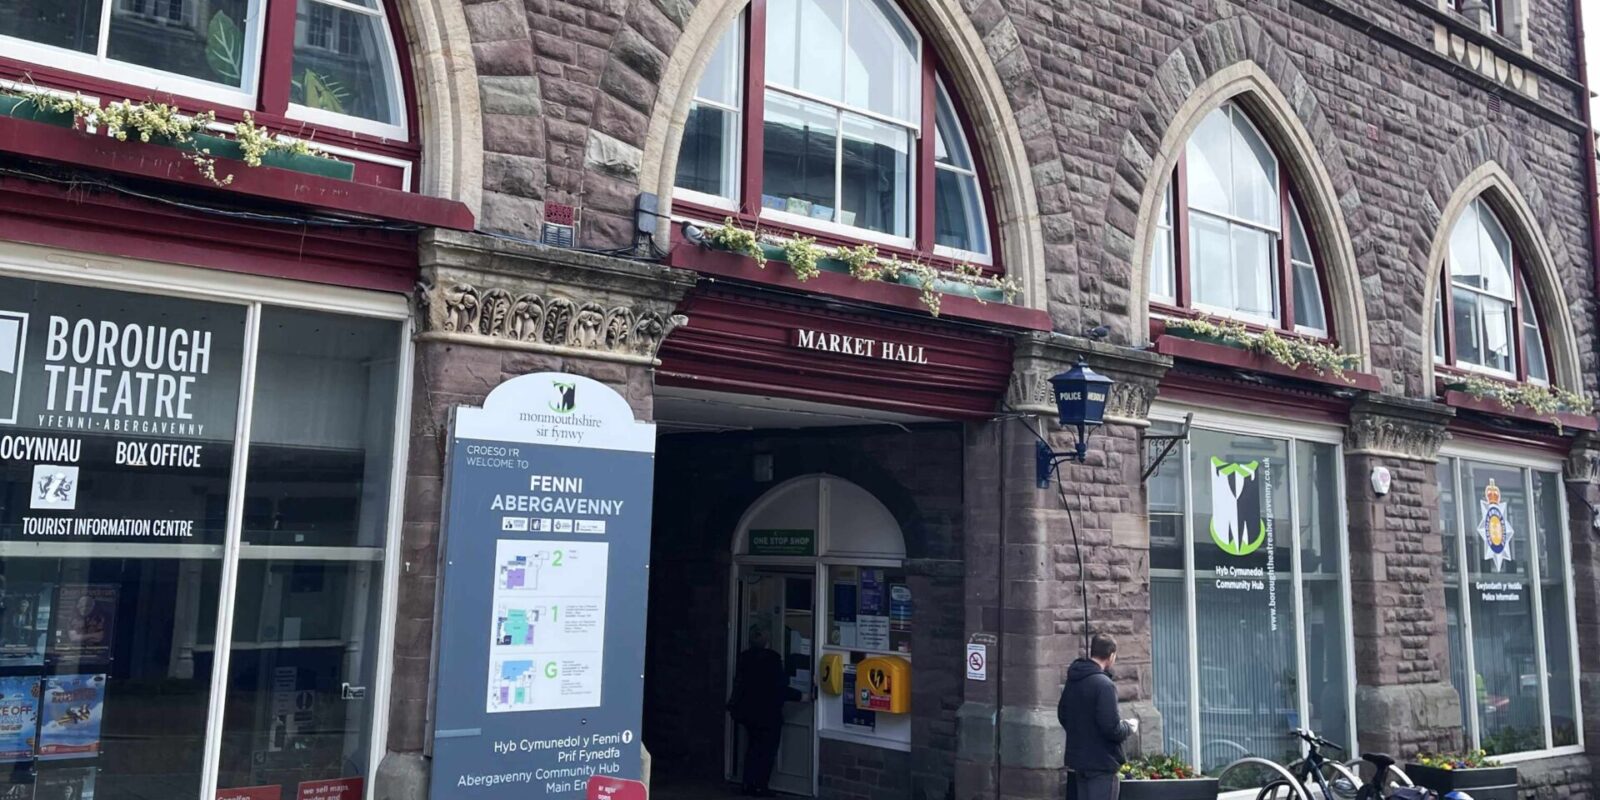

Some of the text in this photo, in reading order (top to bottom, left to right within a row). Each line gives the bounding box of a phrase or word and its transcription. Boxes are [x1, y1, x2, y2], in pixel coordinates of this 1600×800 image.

[46, 315, 211, 375] BOROUGH
[797, 329, 928, 364] MARKET HALL
[44, 364, 197, 420] THEATRE
[1060, 392, 1082, 400] POLICE
[519, 411, 602, 428] monmouthshire
[536, 427, 584, 443] sir fynwy
[0, 435, 82, 463] OCYNNAU
[115, 441, 203, 468] BOX OFFICE
[467, 445, 507, 457] CROESO
[466, 457, 529, 469] WELCOME TO
[530, 475, 583, 493] FENNI
[490, 494, 624, 516] ABERGAVENNY
[22, 517, 194, 537] TOURIST INFORMATION CENTRE
[753, 536, 810, 545] ONE STOP SHOP
[552, 550, 563, 567] 2
[1215, 565, 1228, 577] Hyb
[1216, 579, 1264, 591] Community Hub
[551, 606, 558, 622] 1
[544, 661, 558, 679] G
[11, 705, 33, 715] OFF
[494, 733, 621, 754] Hyb Cymunedol y Fenni
[558, 748, 621, 764] Prif Fynedfa
[457, 762, 620, 787] Abergavenny Community Hub
[316, 785, 328, 793] sell
[546, 780, 571, 794] Main
